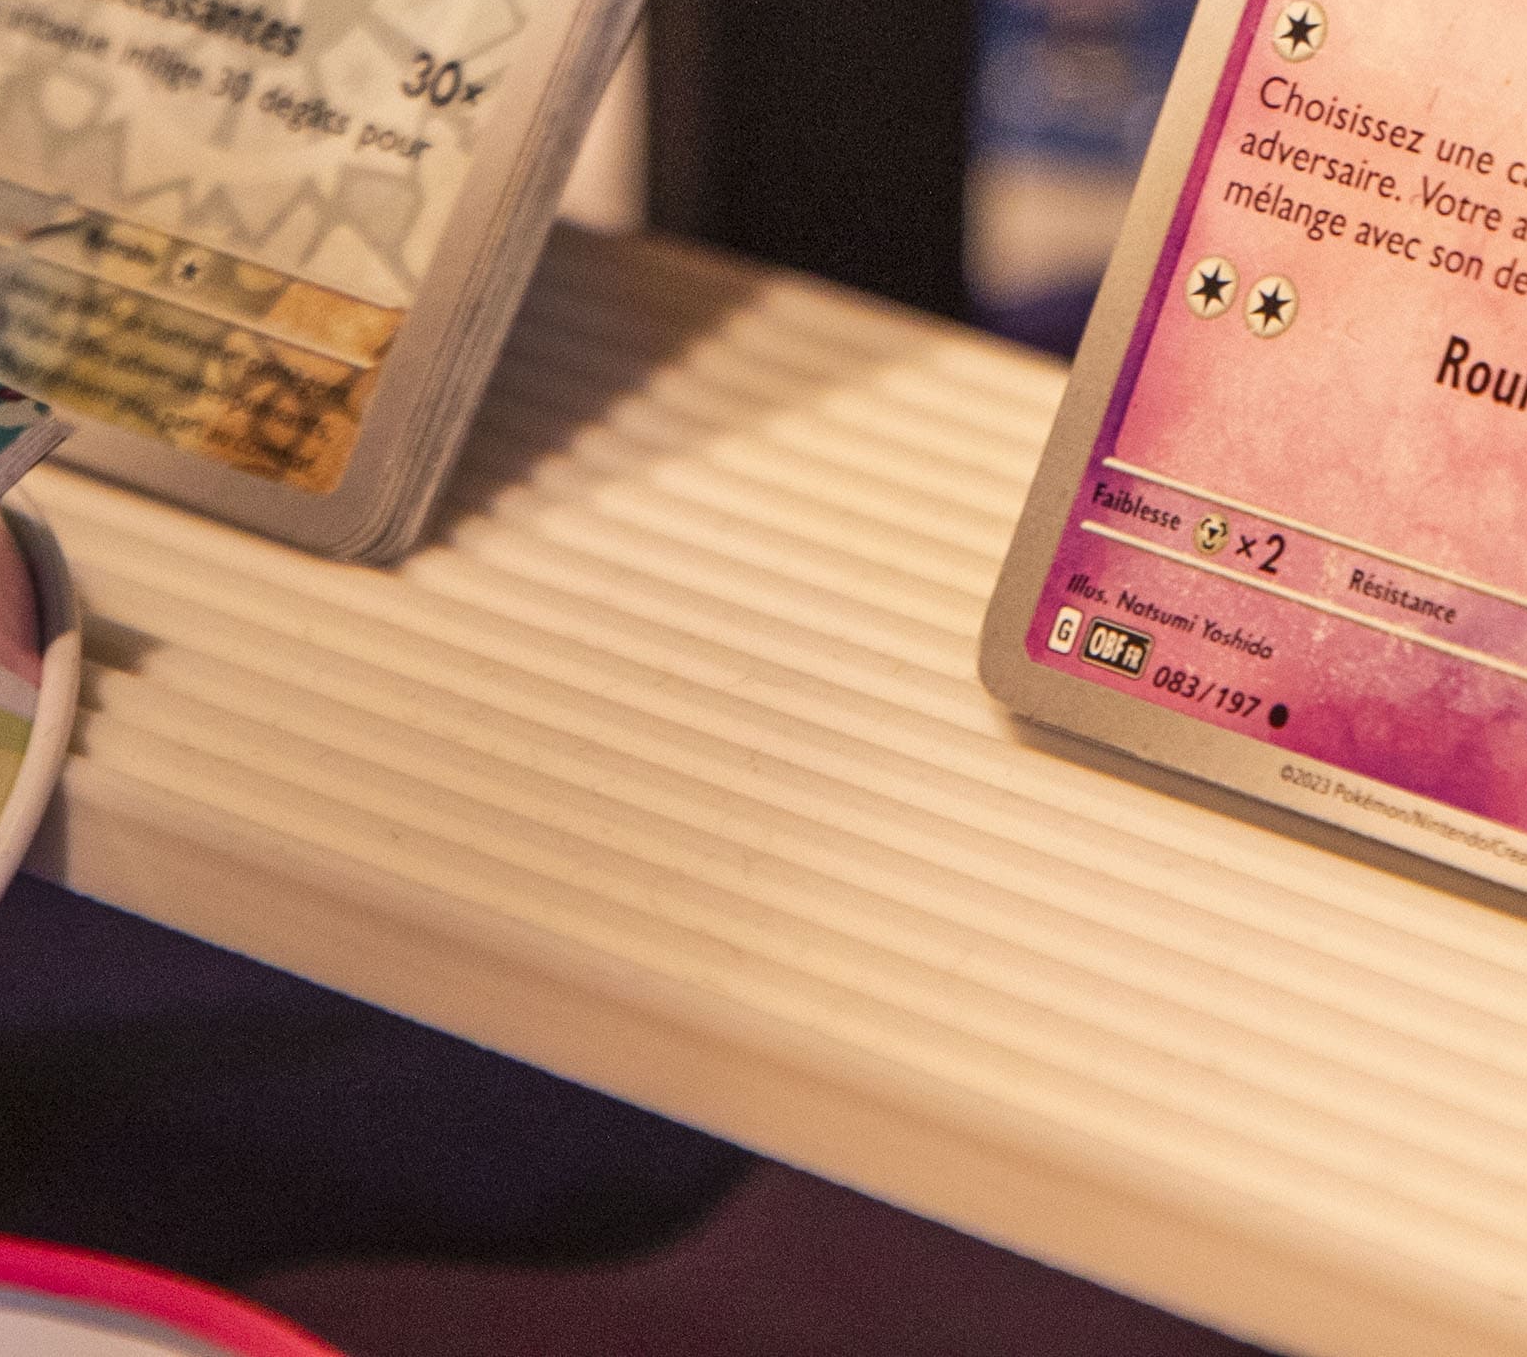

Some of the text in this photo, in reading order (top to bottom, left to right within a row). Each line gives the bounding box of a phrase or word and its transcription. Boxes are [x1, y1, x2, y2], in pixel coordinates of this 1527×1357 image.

[356, 122, 432, 159] pour
[1260, 75, 1427, 154] Choisissez
[1437, 137, 1495, 176] une
[1222, 176, 1348, 242] mélange
[1354, 220, 1419, 261] avec
[1428, 243, 1484, 281] son
[1240, 130, 1403, 202] adversaire.
[1420, 175, 1504, 232] Votre
[1091, 481, 1183, 533] Faiblesse
[1348, 566, 1458, 625] Résistance
[1065, 572, 1275, 660] Illus. Natsumi Yoshida
[1055, 617, 1073, 645] G
[1087, 625, 1126, 665] OBF
[1152, 664, 1263, 719] 083/197
